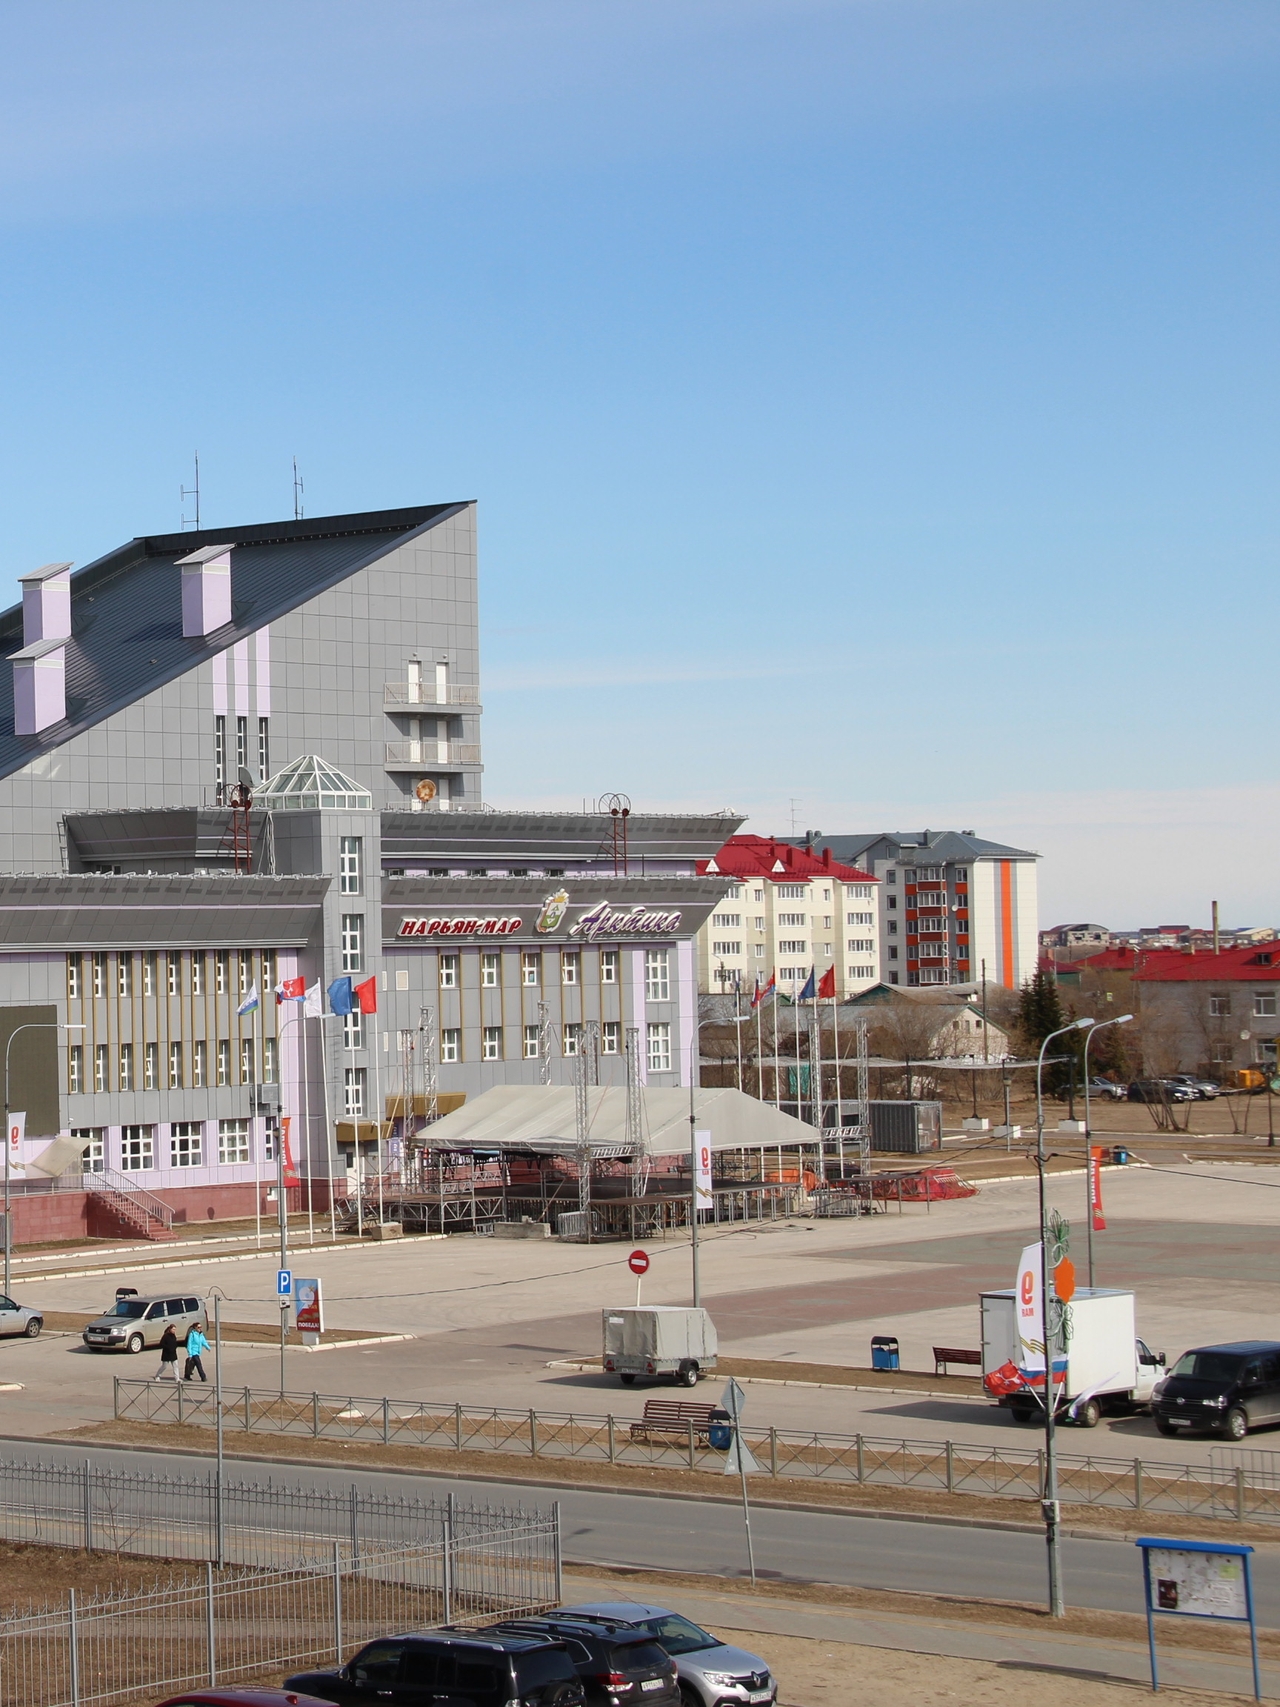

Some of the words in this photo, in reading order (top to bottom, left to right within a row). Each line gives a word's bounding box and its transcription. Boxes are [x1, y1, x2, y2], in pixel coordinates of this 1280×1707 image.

[398, 916, 522, 937] НАРЬЯН-МАР
[570, 900, 682, 943] Арктика
[280, 1272, 289, 1292] P
